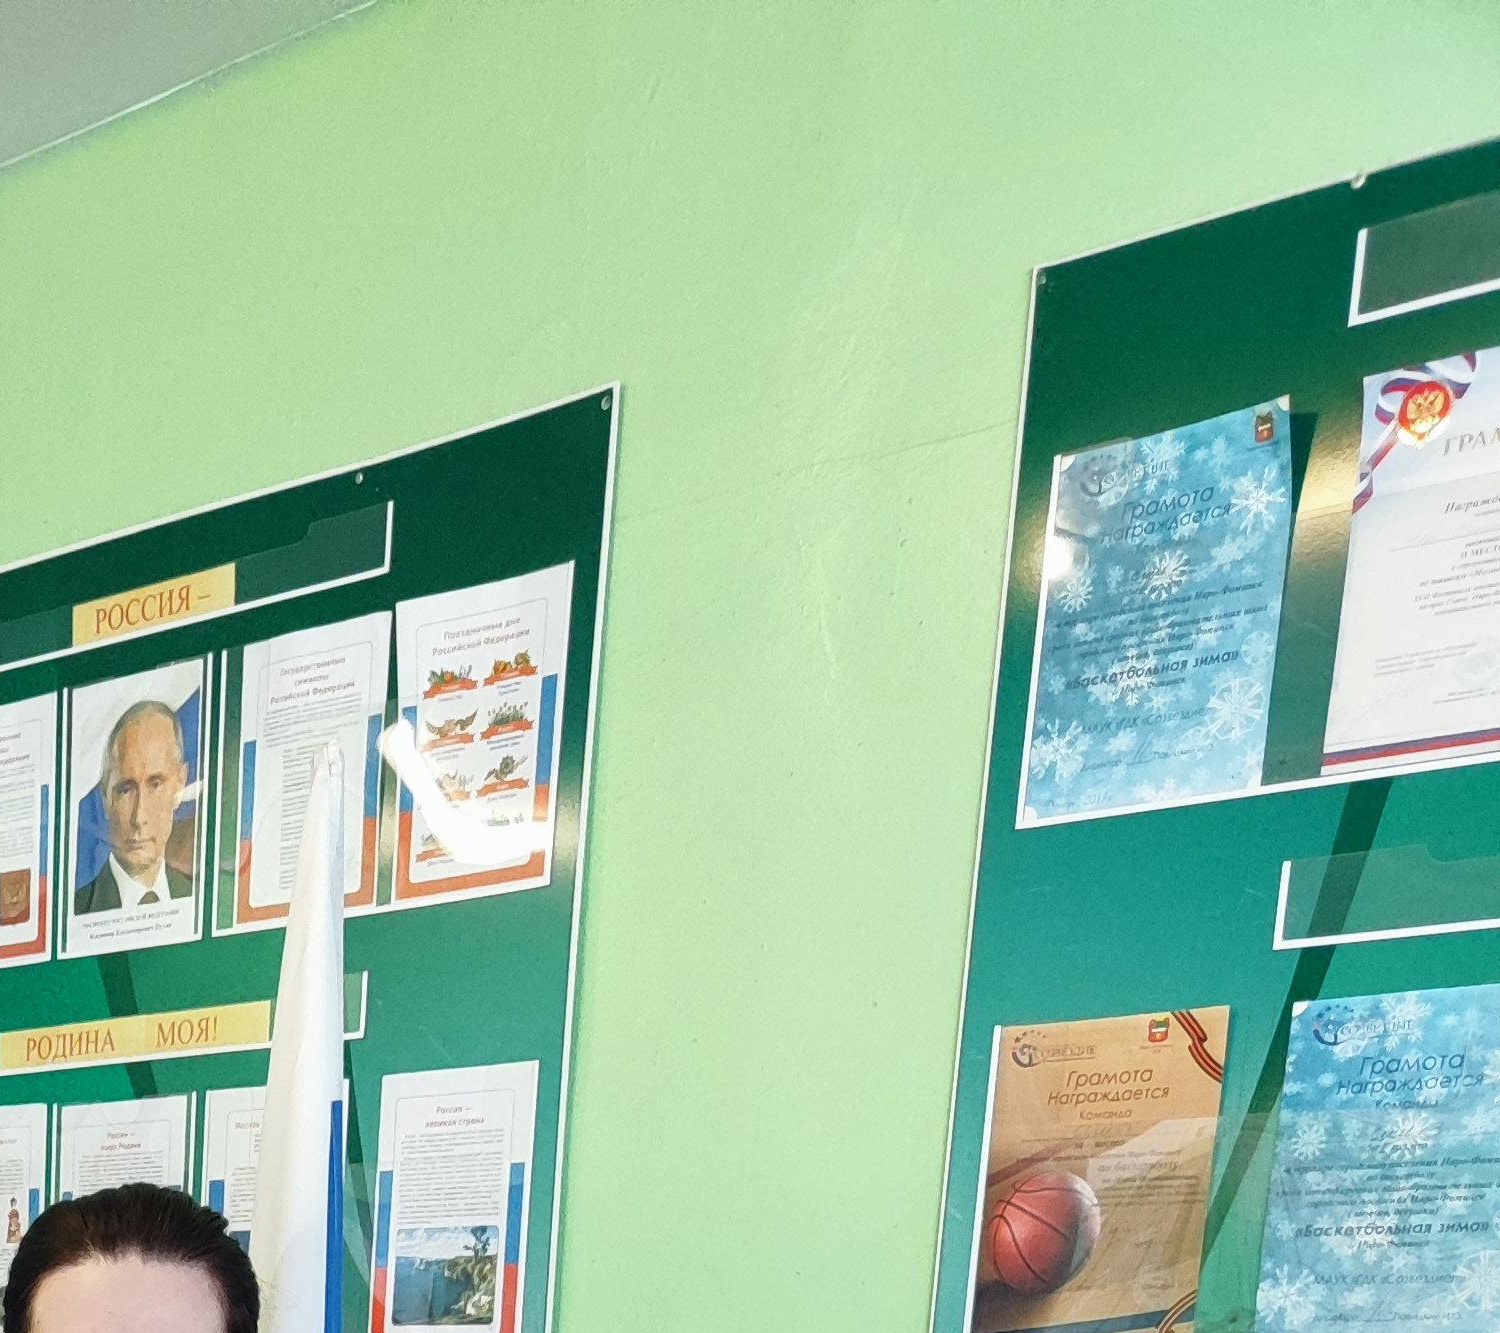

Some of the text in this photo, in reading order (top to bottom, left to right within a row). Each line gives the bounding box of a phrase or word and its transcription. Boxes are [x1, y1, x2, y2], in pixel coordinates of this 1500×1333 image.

[96, 584, 191, 635] РОССИЯ
[25, 1017, 219, 1063] РОДИНА МОЯ!
[1360, 1054, 1466, 1079] Грамота
[1066, 1068, 1154, 1091] Грамота
[1337, 1073, 1485, 1098] Награждается
[1048, 1087, 1170, 1107] Награждается
[1437, 1221, 1490, 1234] зима»
